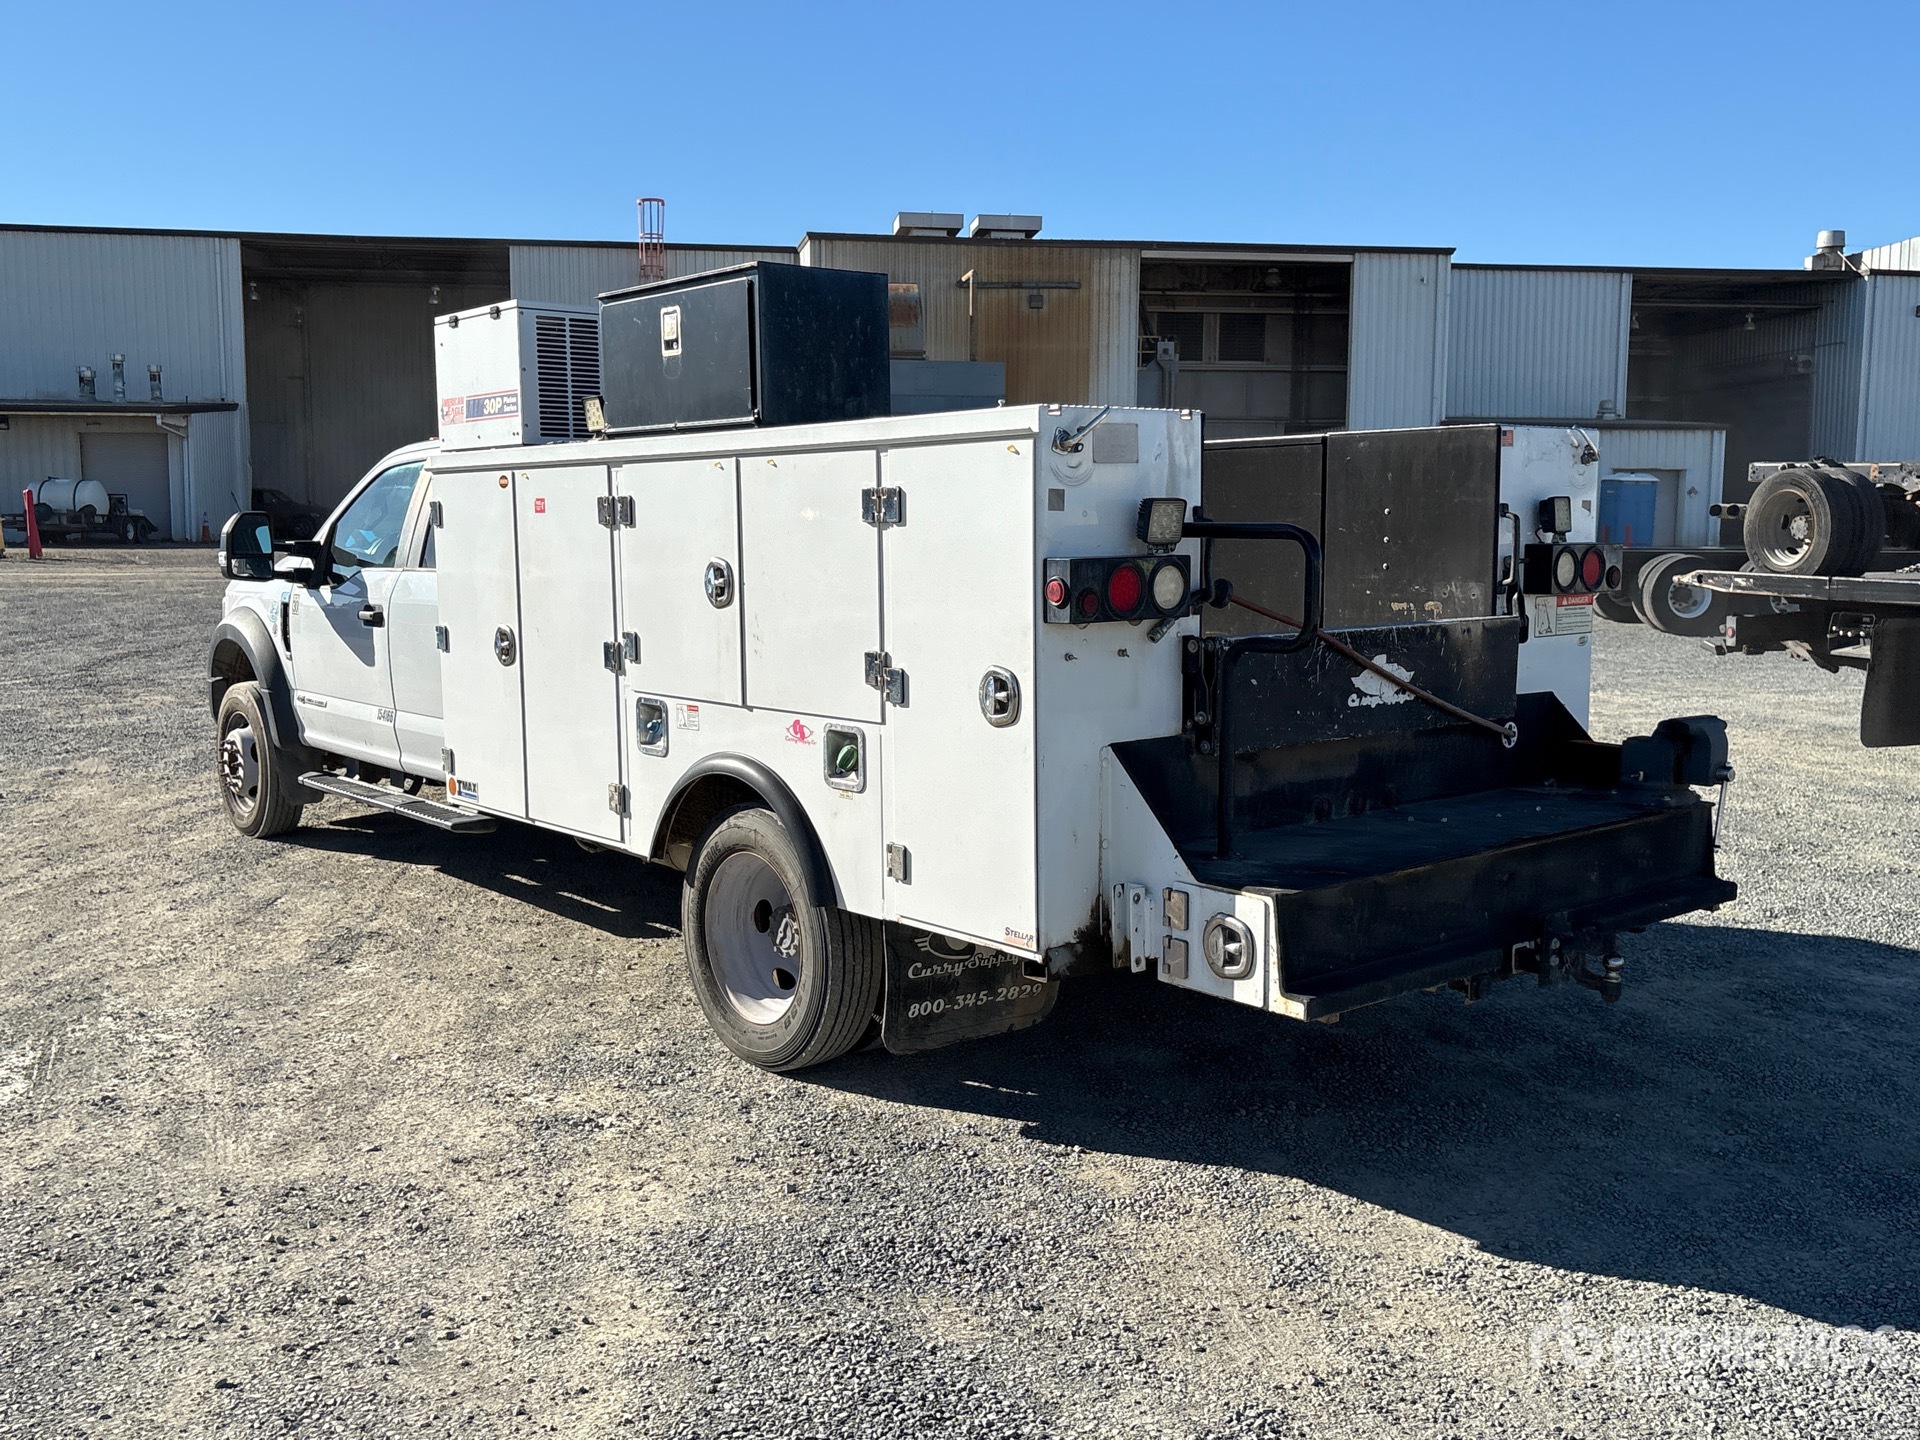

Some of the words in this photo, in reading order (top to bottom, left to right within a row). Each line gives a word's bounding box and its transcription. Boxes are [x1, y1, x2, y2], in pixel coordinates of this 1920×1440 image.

[483, 397, 502, 415] 30P
[1005, 926, 1034, 942] STELLAR
[908, 961, 967, 979] Curry
[908, 983, 1043, 1018] 800-345-2829
